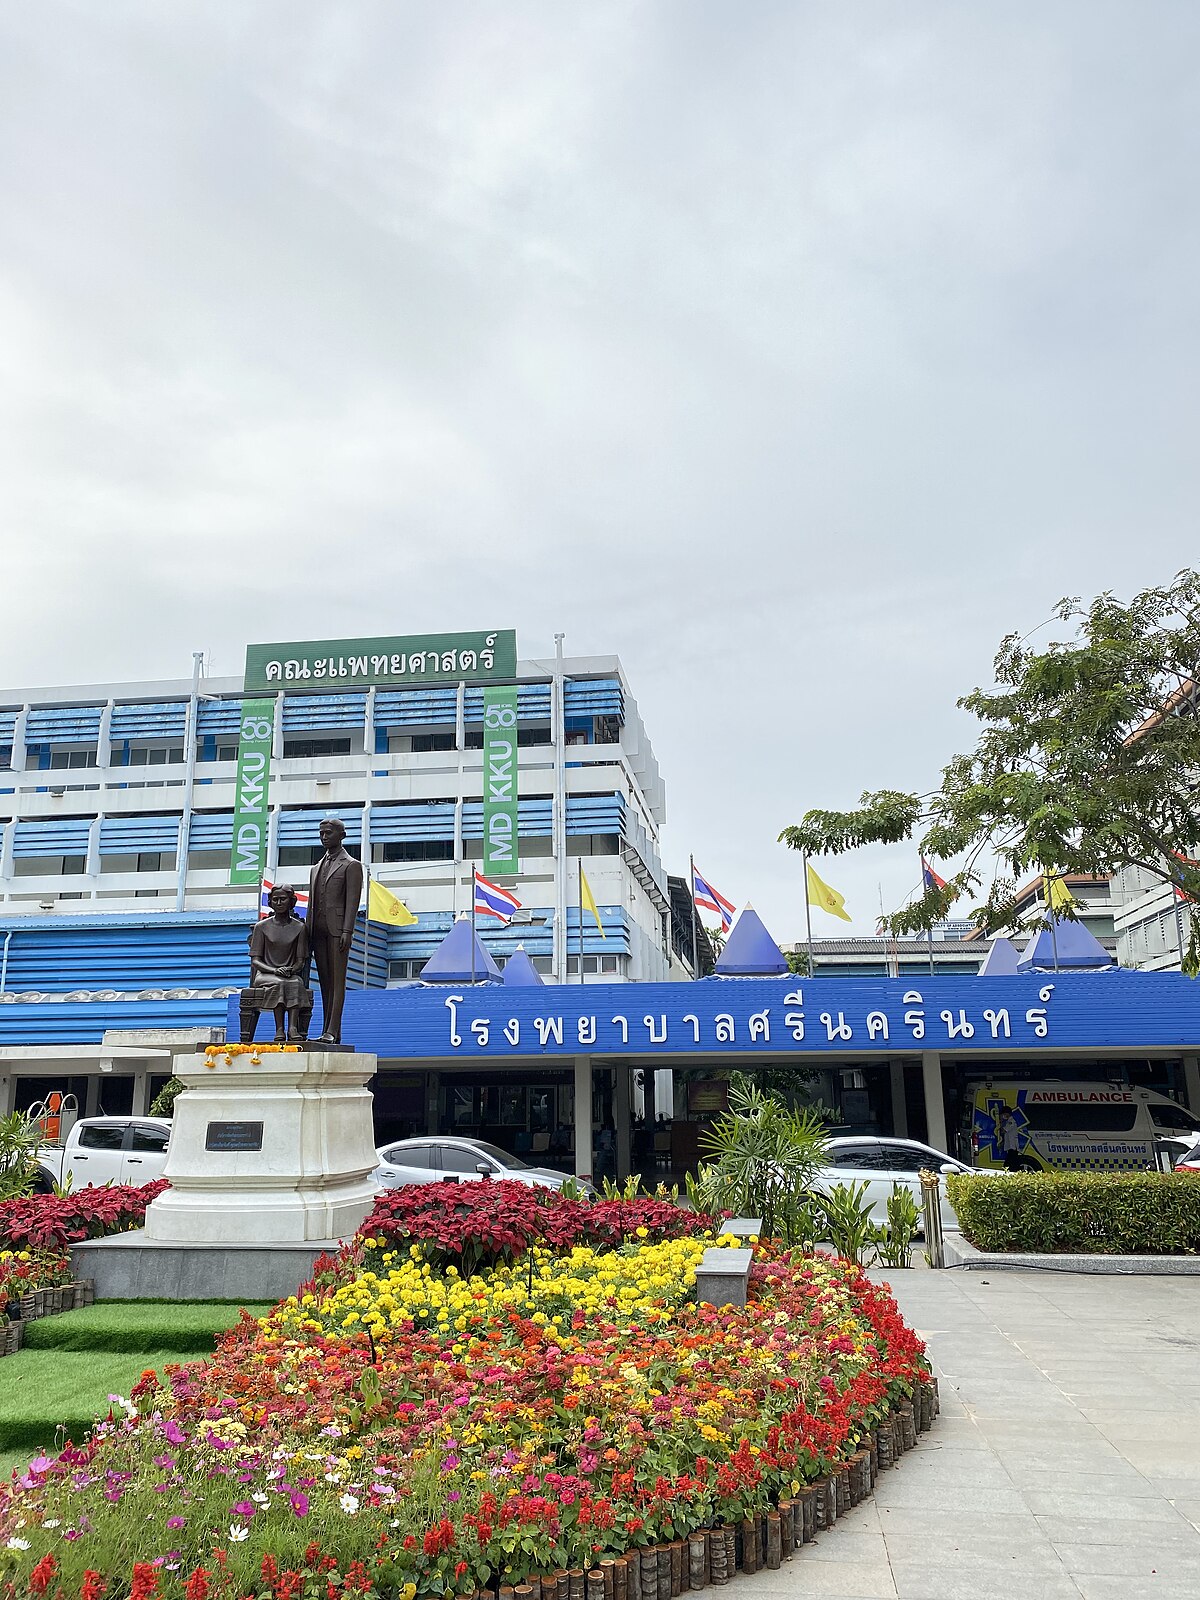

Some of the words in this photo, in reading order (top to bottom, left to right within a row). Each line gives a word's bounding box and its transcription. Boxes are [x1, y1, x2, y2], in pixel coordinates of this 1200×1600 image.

[265, 633, 498, 681] คณะแพทยศาสตร์
[239, 752, 266, 814] KKU
[489, 740, 512, 802] KKU
[236, 823, 261, 871] MD
[489, 813, 513, 861] MD
[445, 983, 1056, 1047] โรงพยาบาลศรีนครินทร์
[1032, 1092, 1134, 1102] AMBULANCE
[1046, 1141, 1147, 1154] โรงพยาบาลศรีนครินทร์
